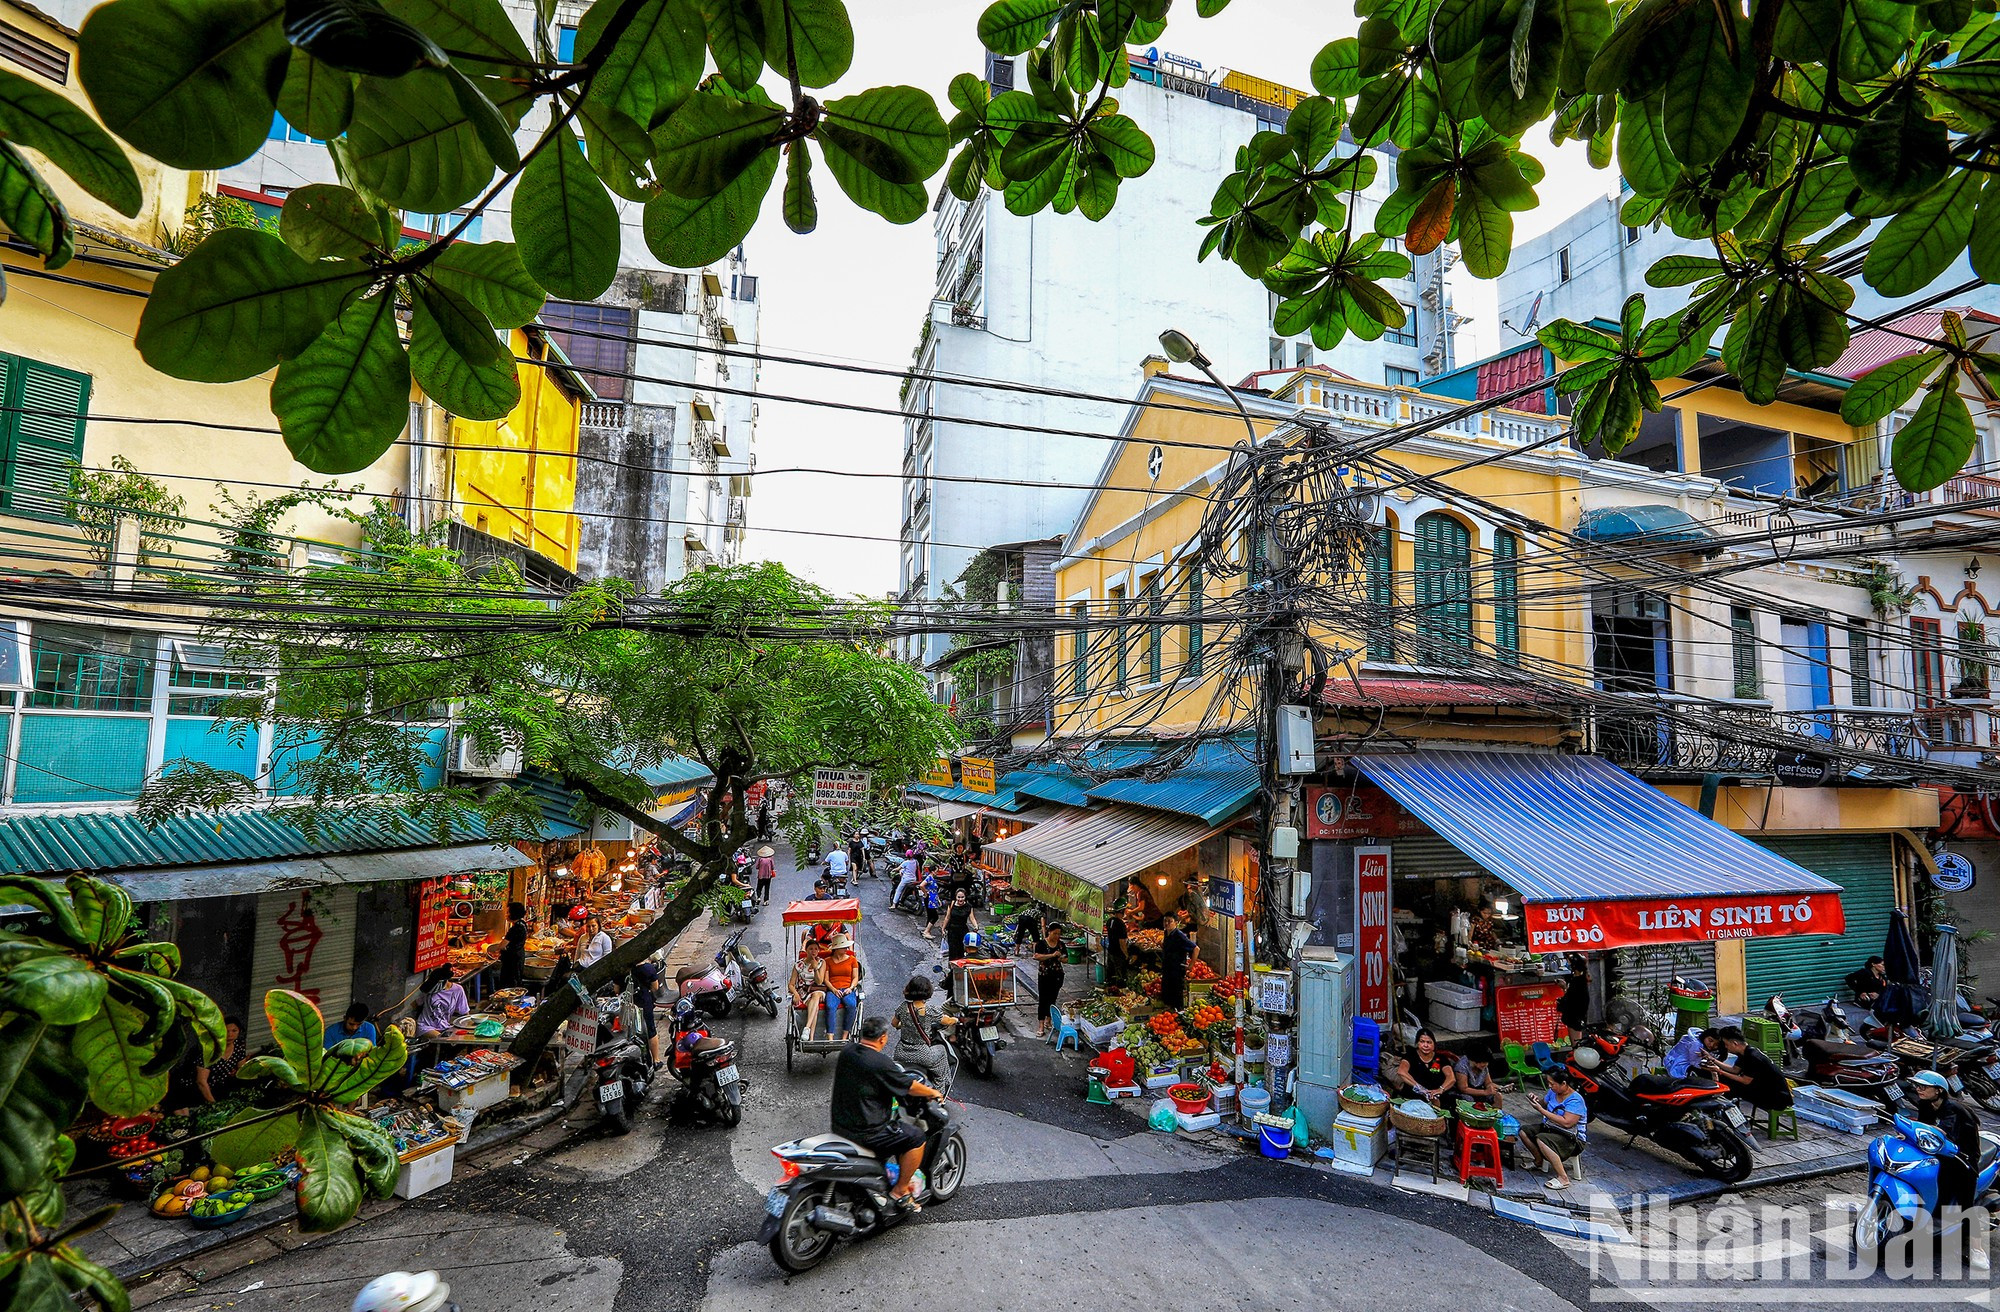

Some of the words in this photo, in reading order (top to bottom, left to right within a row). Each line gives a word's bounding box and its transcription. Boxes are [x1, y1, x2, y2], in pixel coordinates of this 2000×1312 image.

[817, 771, 845, 781] MUA
[1777, 764, 1822, 775] perfetto
[1367, 837, 1376, 845] 17
[1361, 859, 1385, 877] Liên
[1938, 866, 1968, 878] arett
[1362, 891, 1385, 927] SINH
[1545, 904, 1585, 923] BÚN
[1637, 904, 1702, 930] LIÊN
[1709, 905, 1773, 927] SINH
[1778, 896, 1813, 923] TỐ
[1532, 926, 1572, 946] PHÚ
[1575, 924, 1604, 943] ĐÔ
[1706, 930, 1715, 939] 17
[1717, 929, 1733, 938] GIA
[1365, 934, 1383, 987] TỐ
[1369, 998, 1380, 1009] 17
